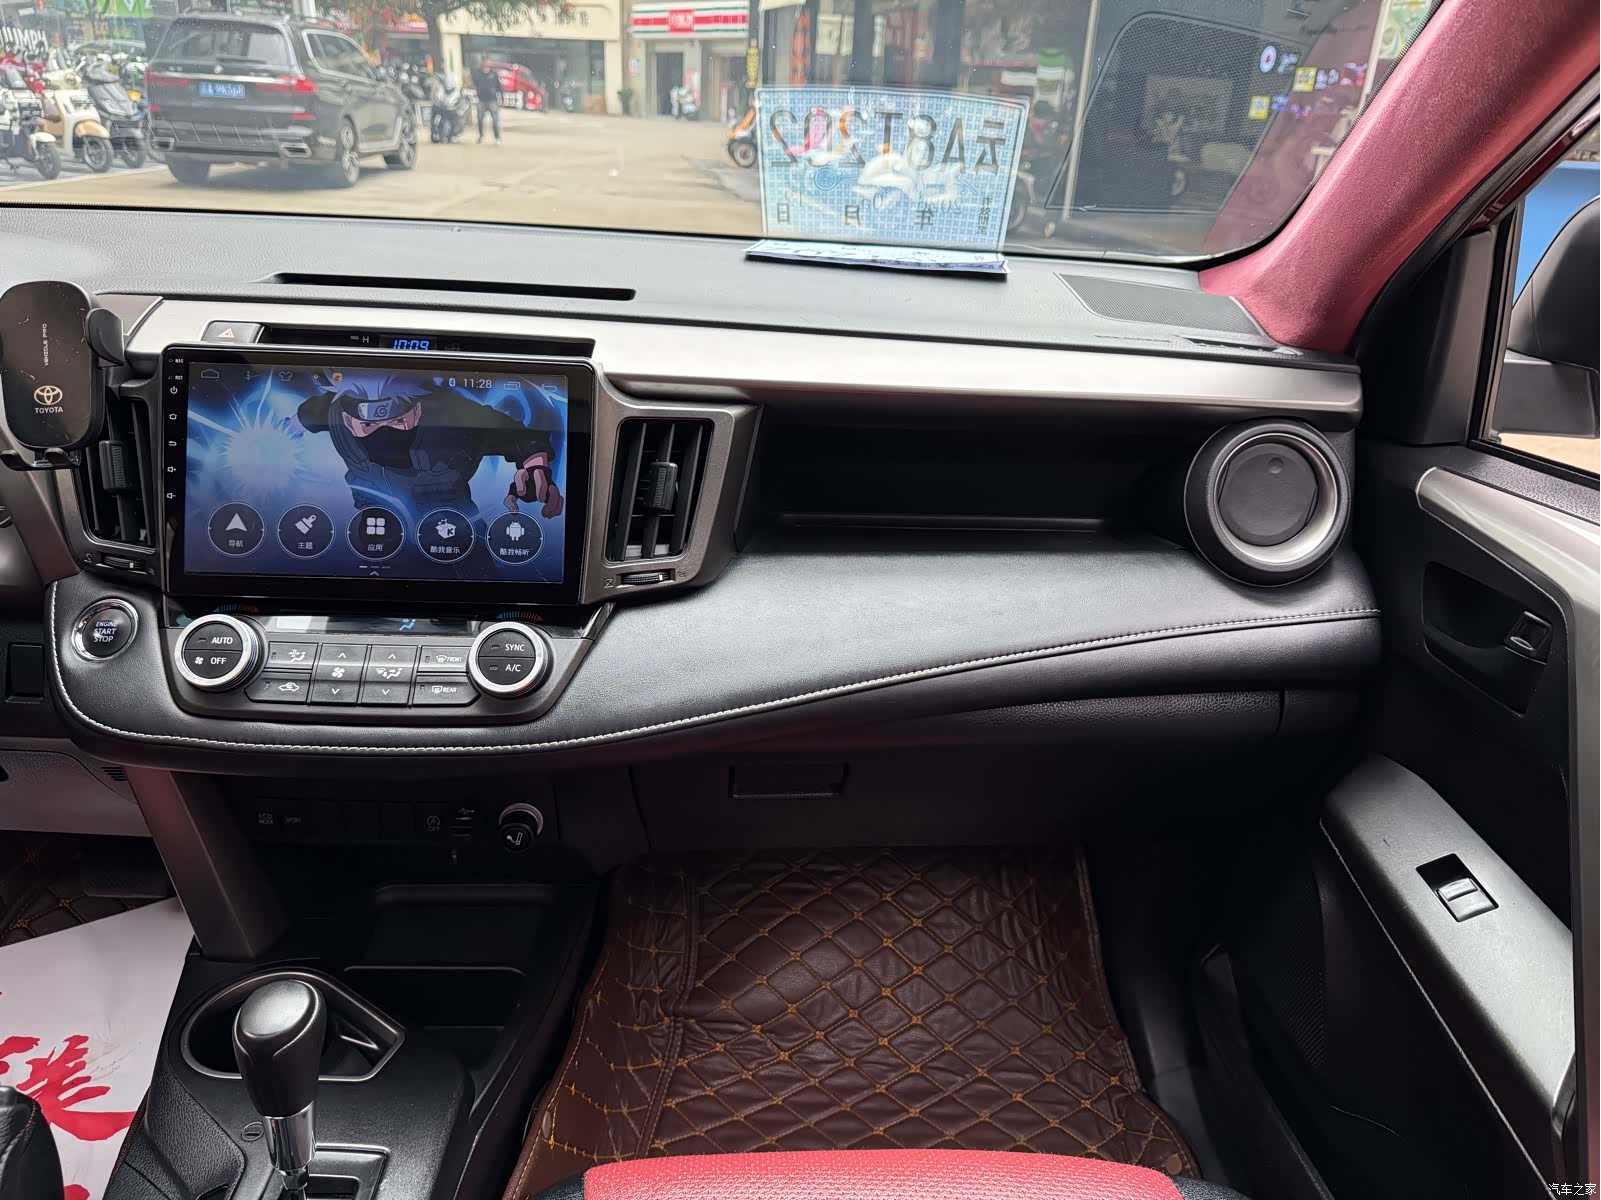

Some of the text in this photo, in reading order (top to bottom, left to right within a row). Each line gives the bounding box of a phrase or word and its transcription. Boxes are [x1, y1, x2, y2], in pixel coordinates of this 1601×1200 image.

[393, 339, 430, 351] 10:09
[463, 377, 493, 390] 11:28
[34, 406, 64, 414] TOYOTA
[228, 539, 244, 548] 导航
[297, 541, 314, 550] 主题
[367, 543, 383, 552] 应用
[429, 545, 461, 554] 酷我音乐
[499, 547, 530, 556] 酷我畅听
[93, 635, 114, 643] STOP
[211, 636, 234, 645] AUTO
[504, 643, 526, 652] SYNC
[210, 657, 227, 665] OFF
[446, 655, 463, 663] FRONT
[505, 663, 521, 672] A/C
